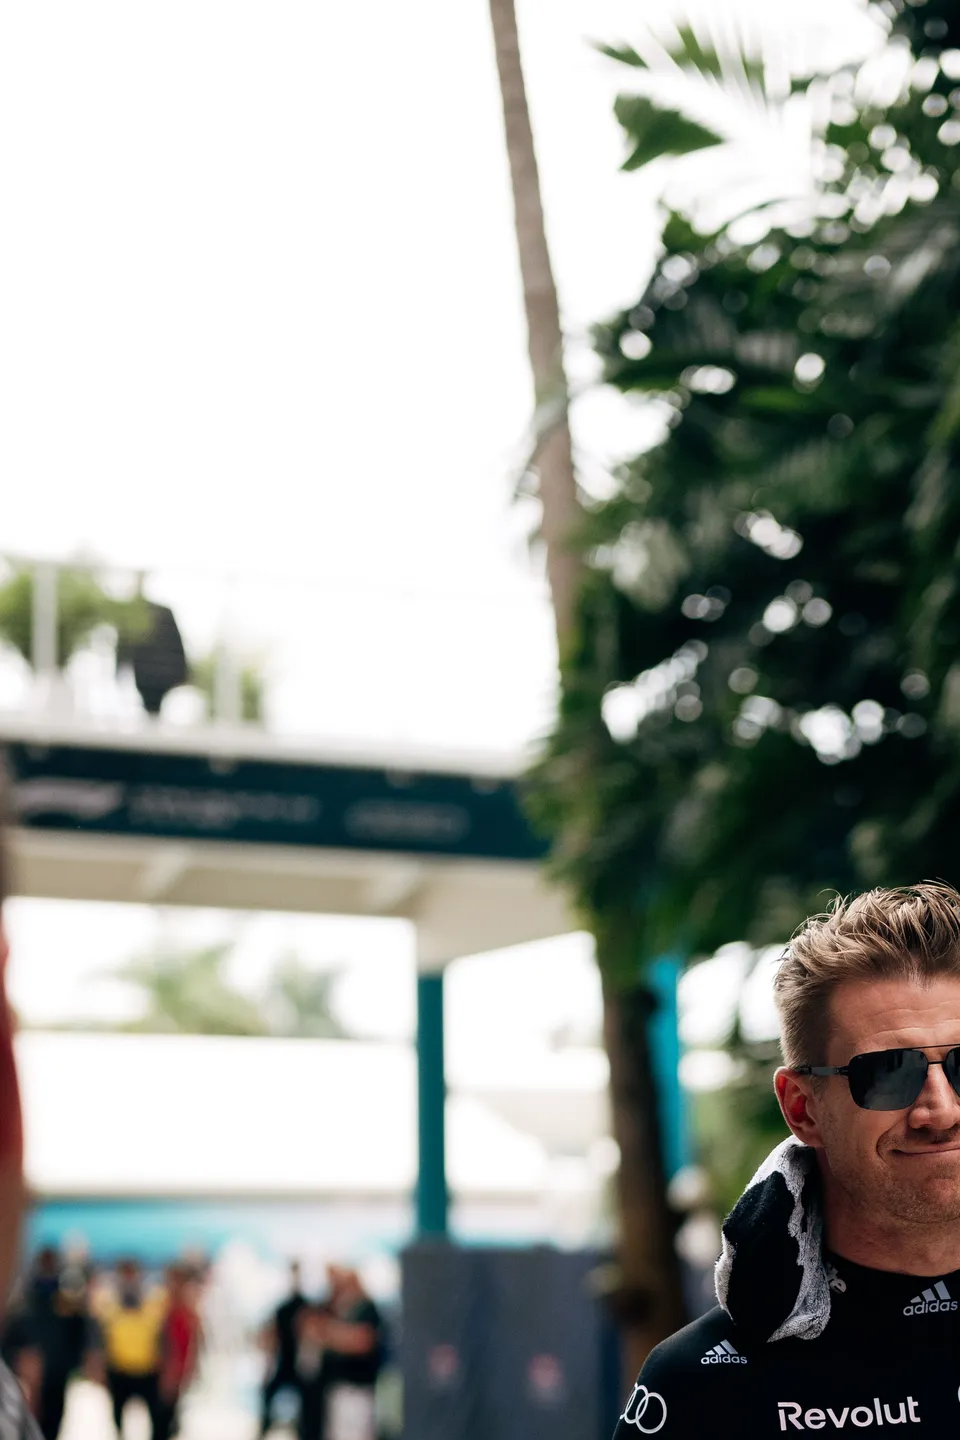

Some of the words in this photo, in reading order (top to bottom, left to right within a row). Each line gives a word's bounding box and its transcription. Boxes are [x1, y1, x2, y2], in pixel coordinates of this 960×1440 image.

[903, 1296, 959, 1318] adidas
[700, 1351, 748, 1366] adidas
[777, 1395, 922, 1432] Revolut
